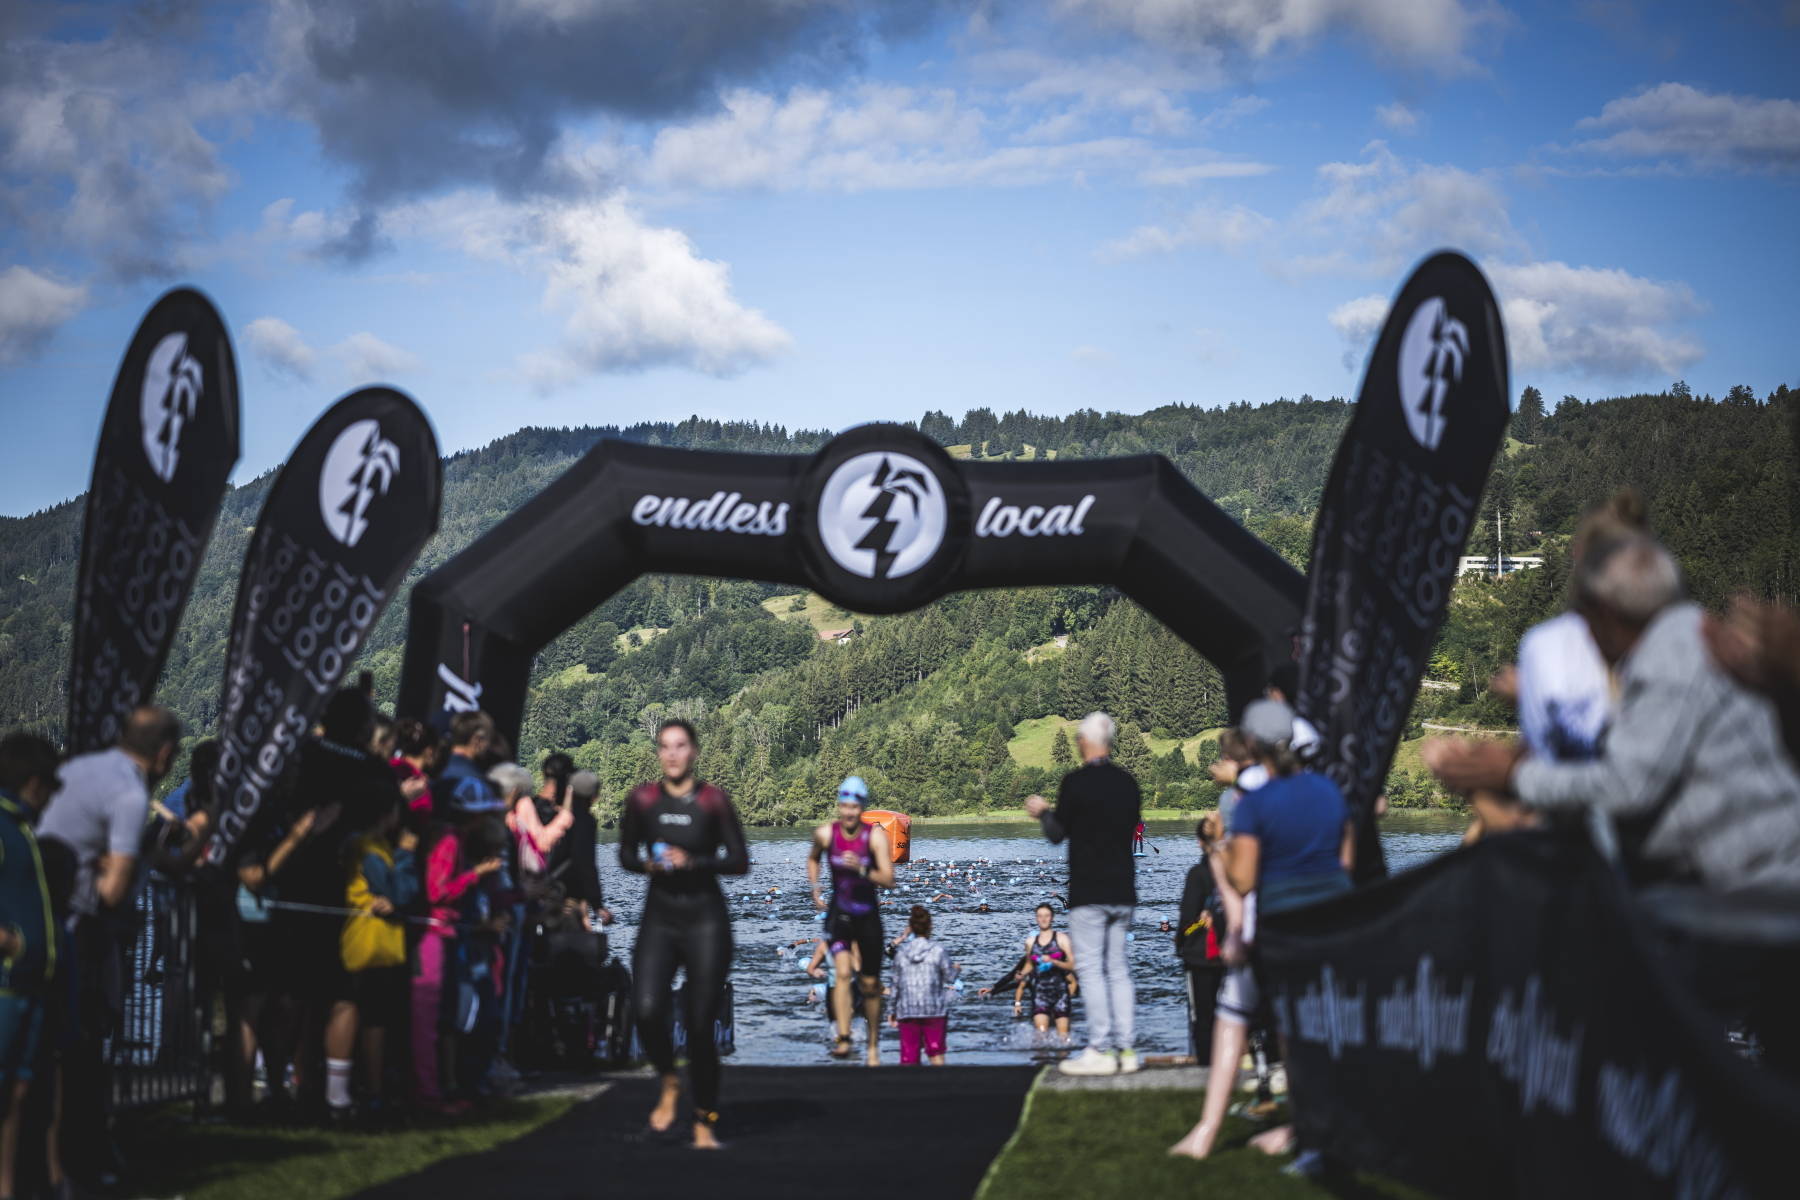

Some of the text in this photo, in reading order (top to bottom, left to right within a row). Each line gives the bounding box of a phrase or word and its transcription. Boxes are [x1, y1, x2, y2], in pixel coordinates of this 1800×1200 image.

[631, 490, 1095, 538] endless local
[1405, 482, 1474, 630] local
[133, 517, 203, 657] local
[261, 547, 328, 646] local
[281, 561, 358, 671] local
[206, 704, 308, 866] endless
[304, 574, 387, 694] local
